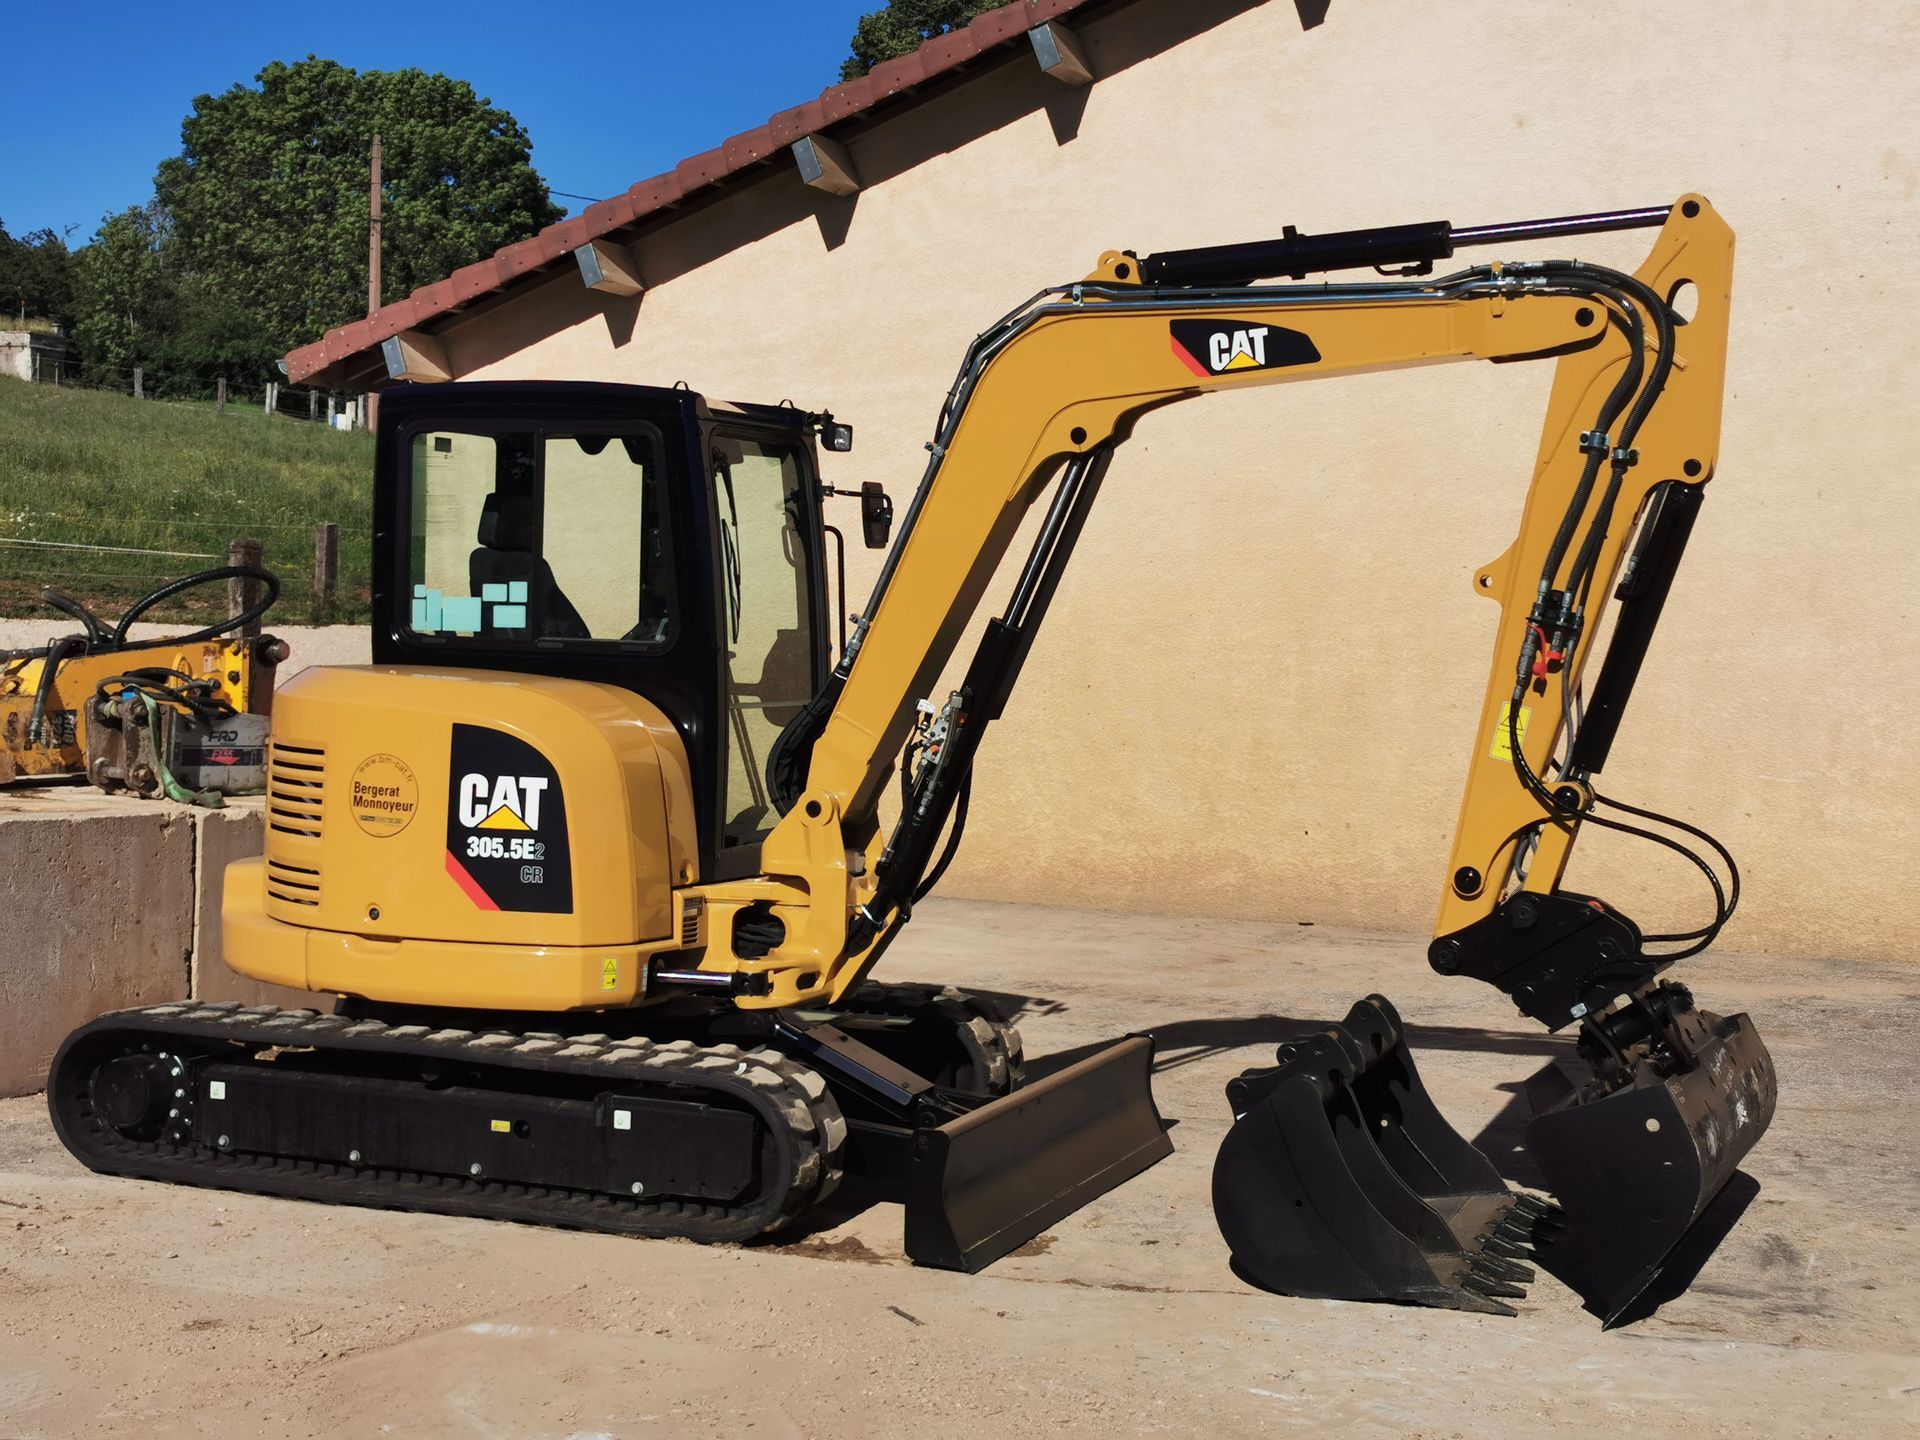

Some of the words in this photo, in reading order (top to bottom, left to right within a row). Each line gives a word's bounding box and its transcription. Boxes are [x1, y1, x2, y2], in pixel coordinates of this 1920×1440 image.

[1209, 327, 1268, 371] CAT
[208, 730, 238, 742] FRD
[354, 781, 400, 798] Bergerat
[353, 795, 414, 813] Monnoyeur
[459, 773, 548, 831] CAT
[520, 865, 544, 883] CR
